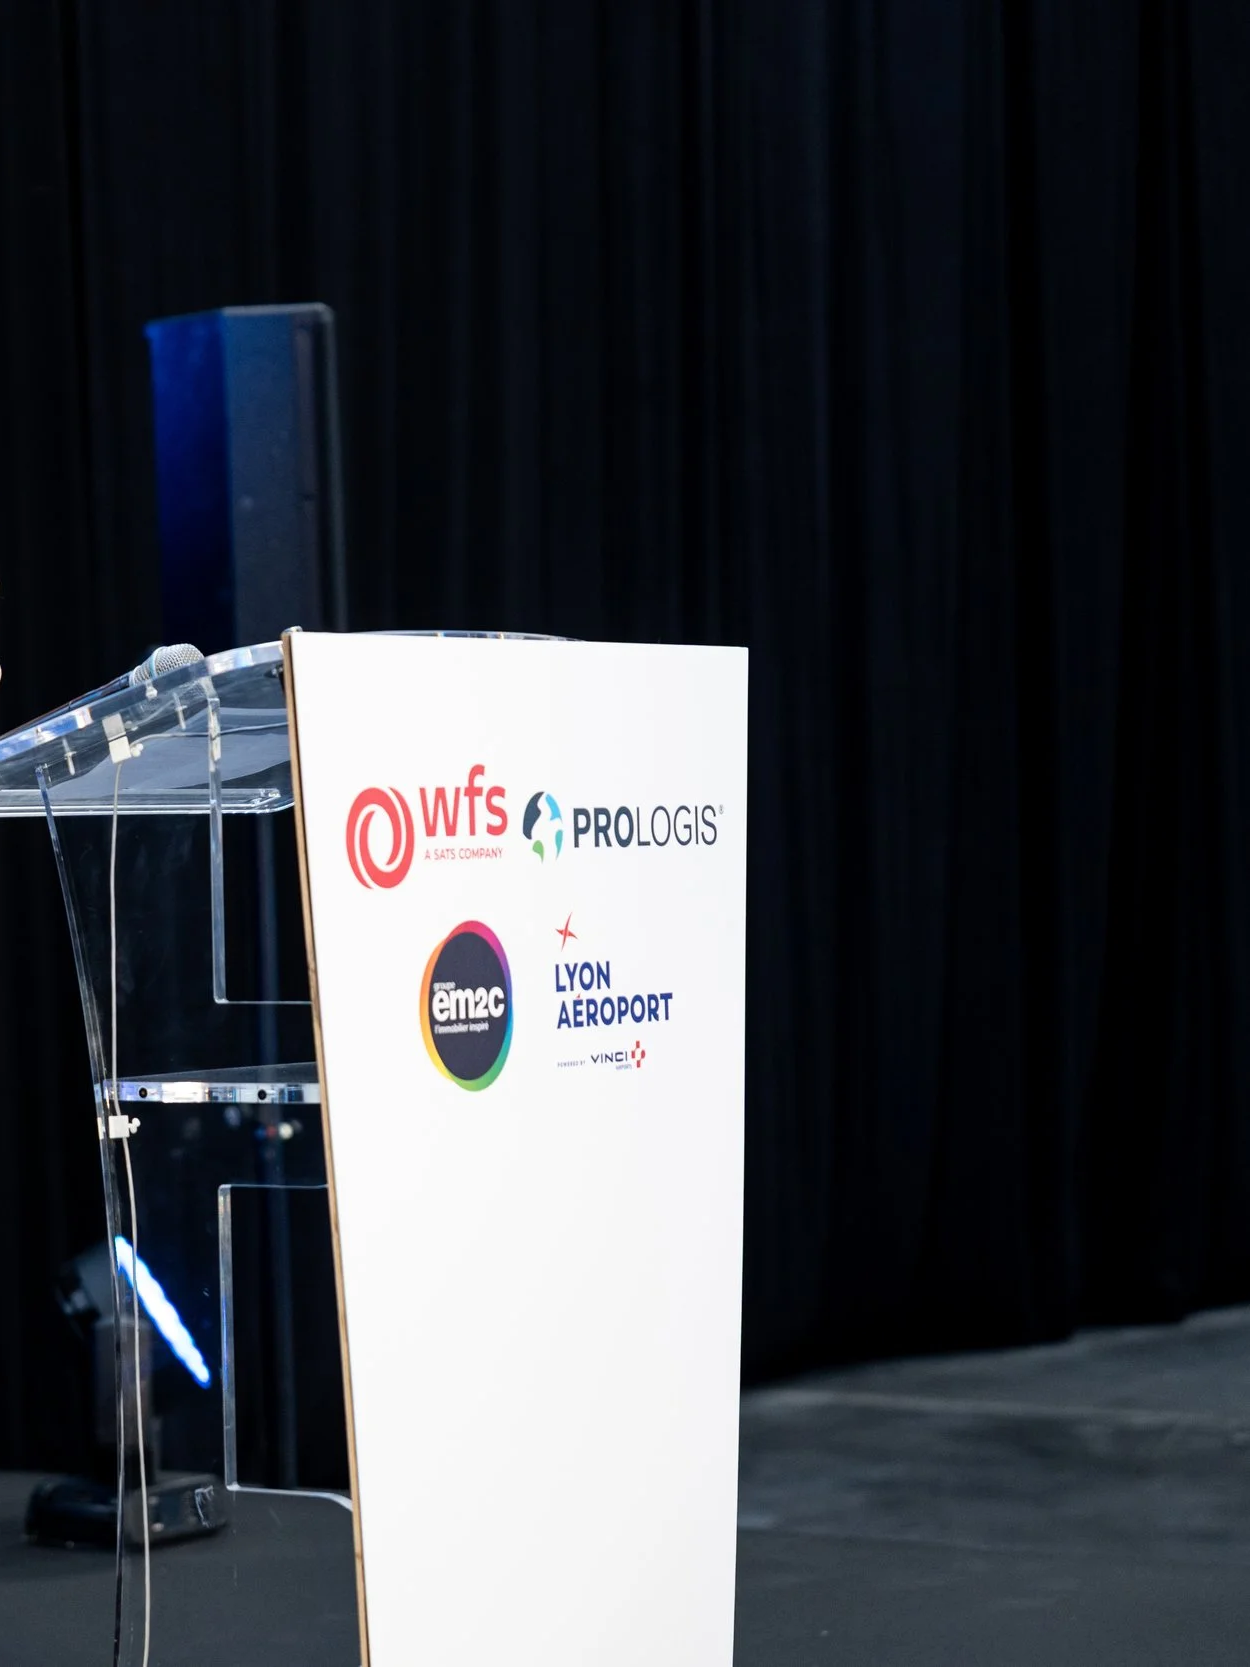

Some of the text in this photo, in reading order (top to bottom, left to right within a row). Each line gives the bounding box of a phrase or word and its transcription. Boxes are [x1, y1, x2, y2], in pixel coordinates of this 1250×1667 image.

[419, 764, 508, 837] wfs
[425, 847, 503, 860] A SATS COMPANY
[555, 961, 610, 992] LYON
[432, 986, 505, 1022] em2c
[557, 992, 673, 1029] AÉROPORT
[591, 1051, 628, 1064] VINCI
